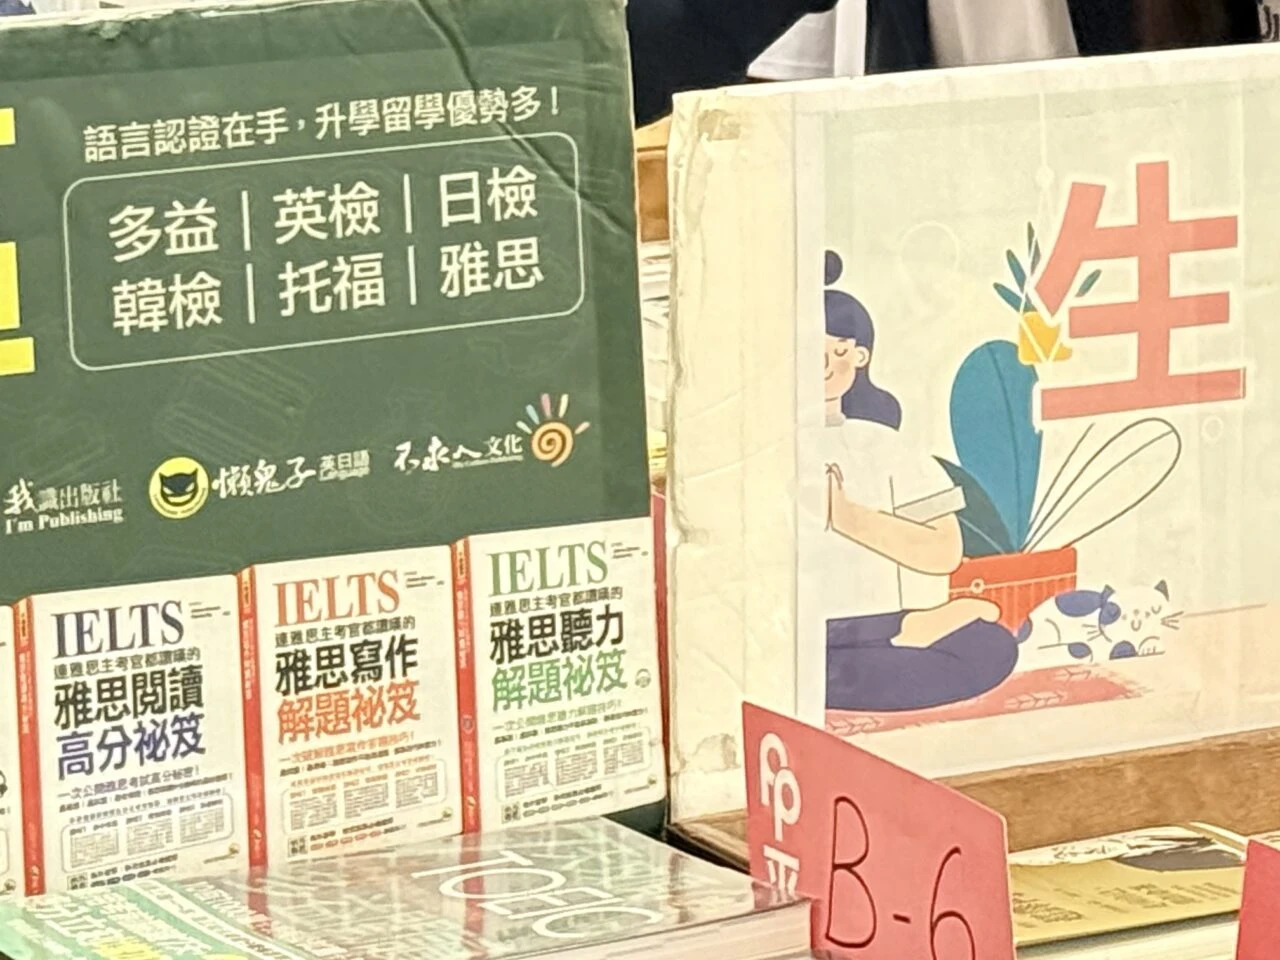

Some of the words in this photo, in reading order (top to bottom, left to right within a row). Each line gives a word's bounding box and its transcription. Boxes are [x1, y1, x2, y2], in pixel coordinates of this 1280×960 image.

[108, 197, 220, 263] 多益
[273, 180, 382, 244] 英檢
[439, 164, 538, 227] 日檢
[112, 270, 224, 336] 韓檢
[278, 252, 386, 317] 托福
[440, 236, 544, 298] 雅思
[5, 517, 33, 535] I'm
[38, 507, 124, 531] Publishing
[272, 569, 400, 628] IELTS
[487, 540, 608, 598] IELTS
[51, 600, 184, 660] IELTS
[489, 603, 626, 666] 雅思聽力
[275, 633, 419, 697] 雅思寫作
[54, 664, 205, 731] 雅思閱讀
[411, 850, 666, 940] TOEIC
[825, 796, 977, 960] B-6
